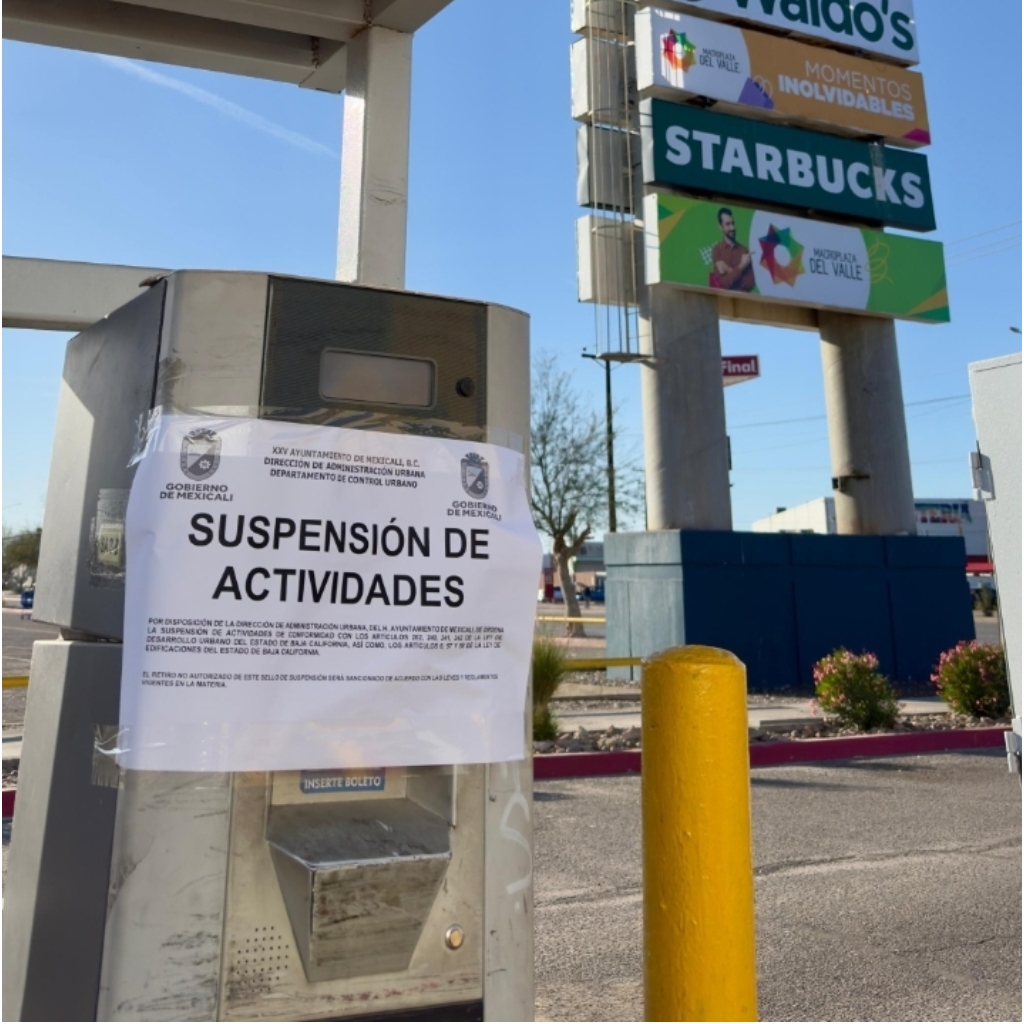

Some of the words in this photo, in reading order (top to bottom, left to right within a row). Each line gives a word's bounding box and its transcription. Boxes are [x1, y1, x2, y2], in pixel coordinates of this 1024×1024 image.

[699, 54, 715, 66] DEL
[716, 56, 740, 73] VALLE
[805, 60, 912, 101] MOMENTOS
[778, 74, 915, 121] INOLVIDABLES
[665, 125, 925, 208] STARBUCKS
[813, 248, 857, 263] MACROPLAZA
[809, 258, 829, 275] DEL
[833, 263, 863, 281] VALLE
[272, 446, 288, 457] XXV
[290, 447, 351, 462] AYUNTAMIENTO
[354, 455, 365, 463] DE
[366, 456, 405, 467] MEXICALI,
[264, 457, 310, 469] DIRECCIÓN
[312, 461, 323, 469] DE
[326, 462, 393, 476] ADMINISTRACIÓN
[395, 469, 425, 479] URBANA
[270, 468, 336, 481] DEPARTAMENTO
[348, 476, 383, 486] CONTROL
[385, 478, 417, 488] URBANO
[159, 491, 175, 499] DE
[176, 492, 233, 502] MEXICALI
[166, 482, 228, 493] GOBIERNO
[447, 508, 460, 516] DE
[452, 500, 497, 512] GOBIERNO
[188, 513, 430, 558] SUSPENSIÓN
[444, 527, 490, 559] DE
[212, 566, 465, 607] ACTIVIDADES
[304, 777, 344, 789] INSERTE
[345, 776, 381, 787] BOLETO
